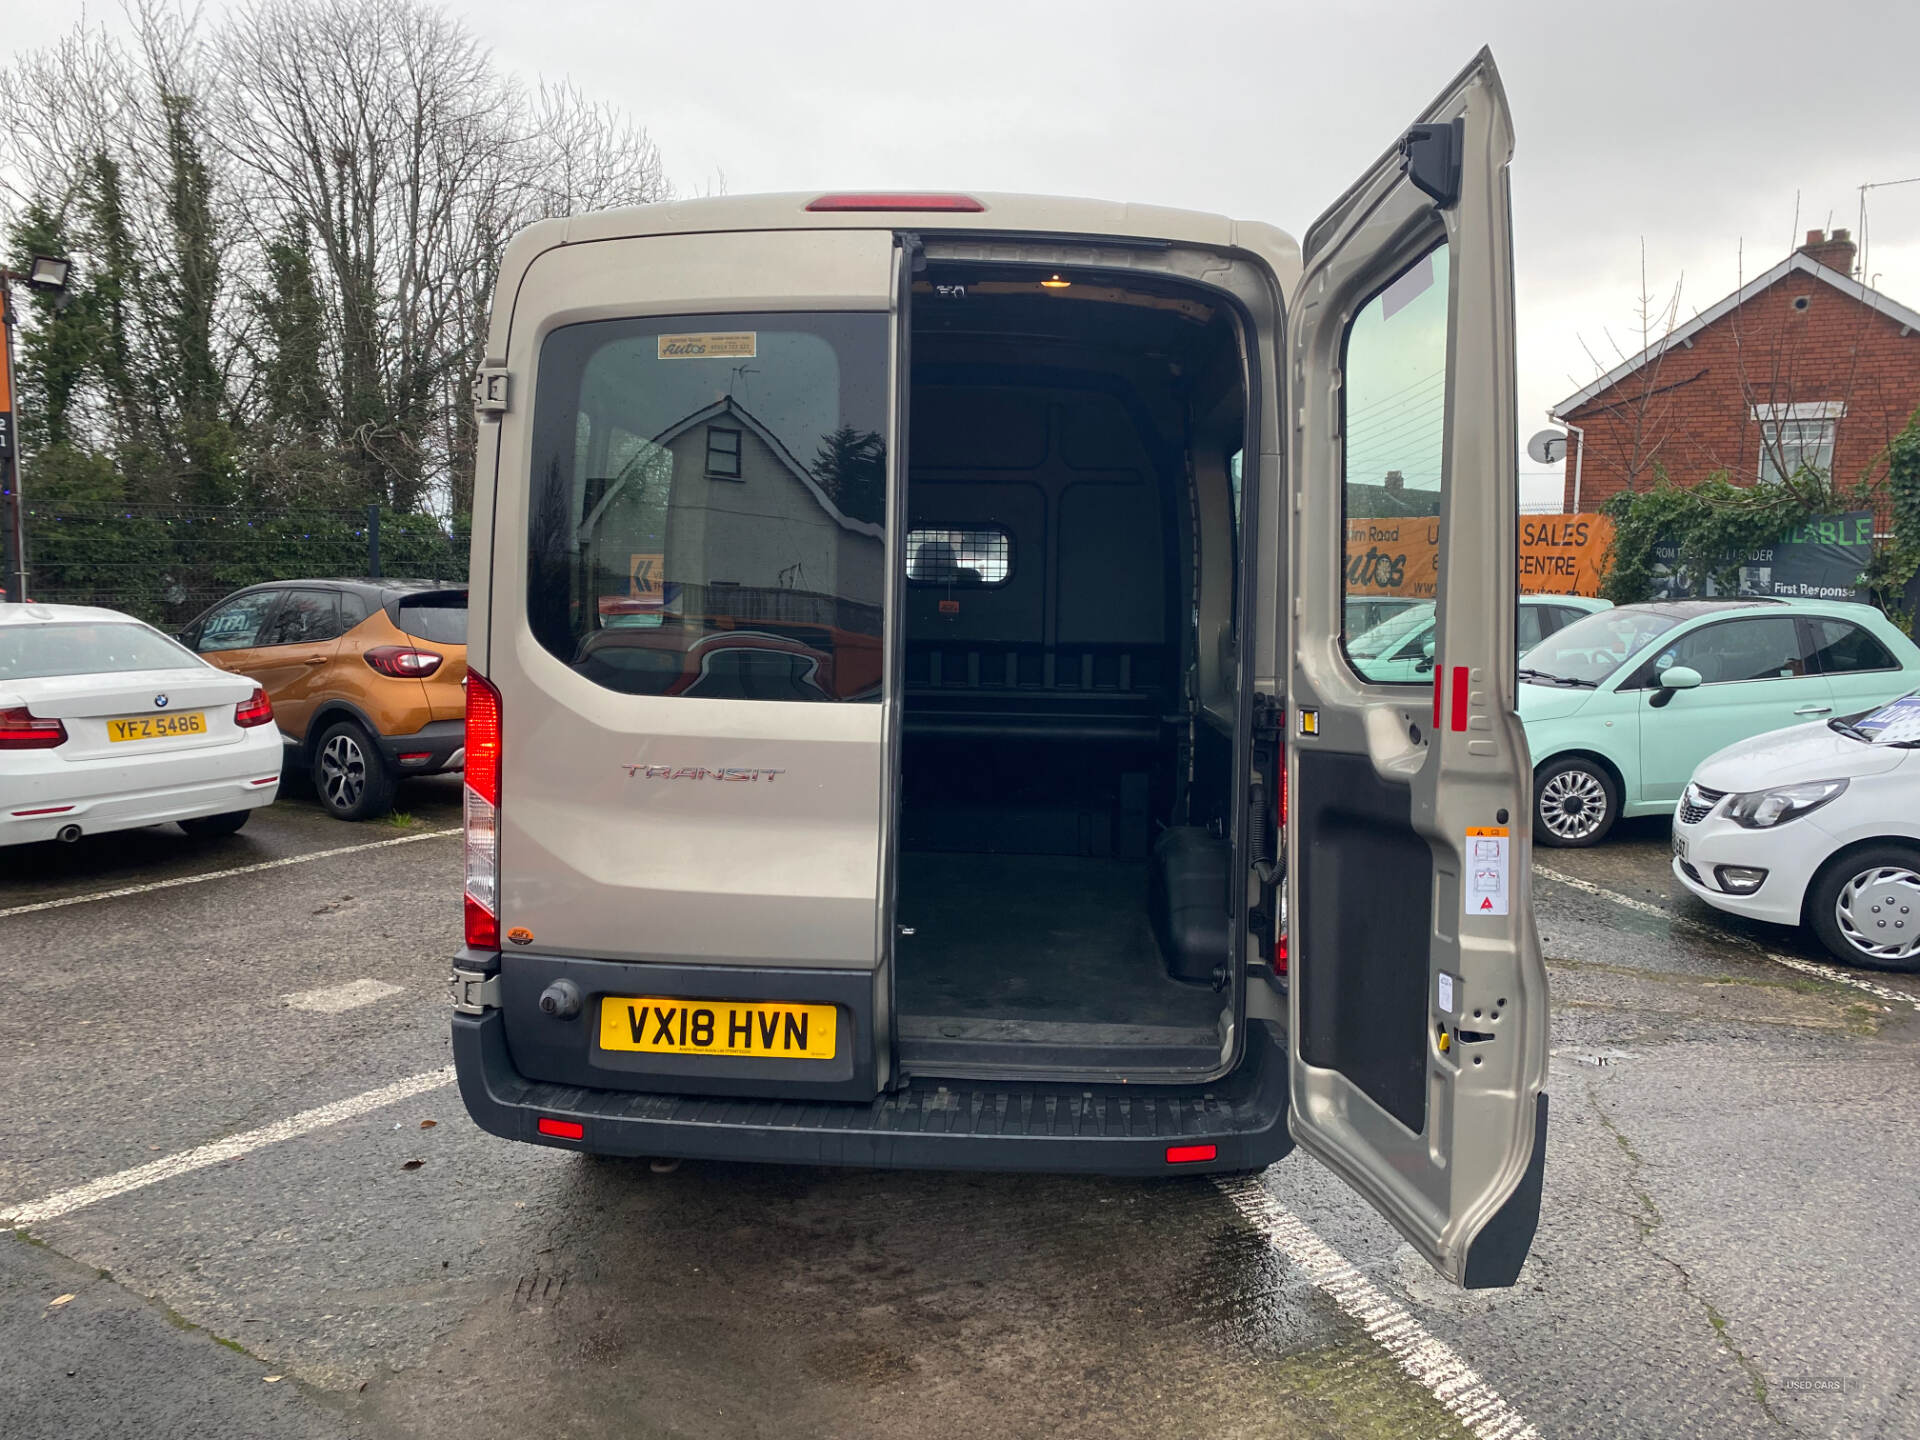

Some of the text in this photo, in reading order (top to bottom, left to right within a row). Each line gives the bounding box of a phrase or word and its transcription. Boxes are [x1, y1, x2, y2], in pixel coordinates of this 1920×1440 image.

[1369, 525, 1399, 542] Road
[1523, 522, 1589, 547] SALES
[1346, 546, 1407, 588] utos
[1774, 582, 1797, 594] First
[115, 716, 199, 738] YFZ 5486
[622, 764, 786, 782] TRANSIT
[627, 1006, 809, 1050] VX18 HVN
